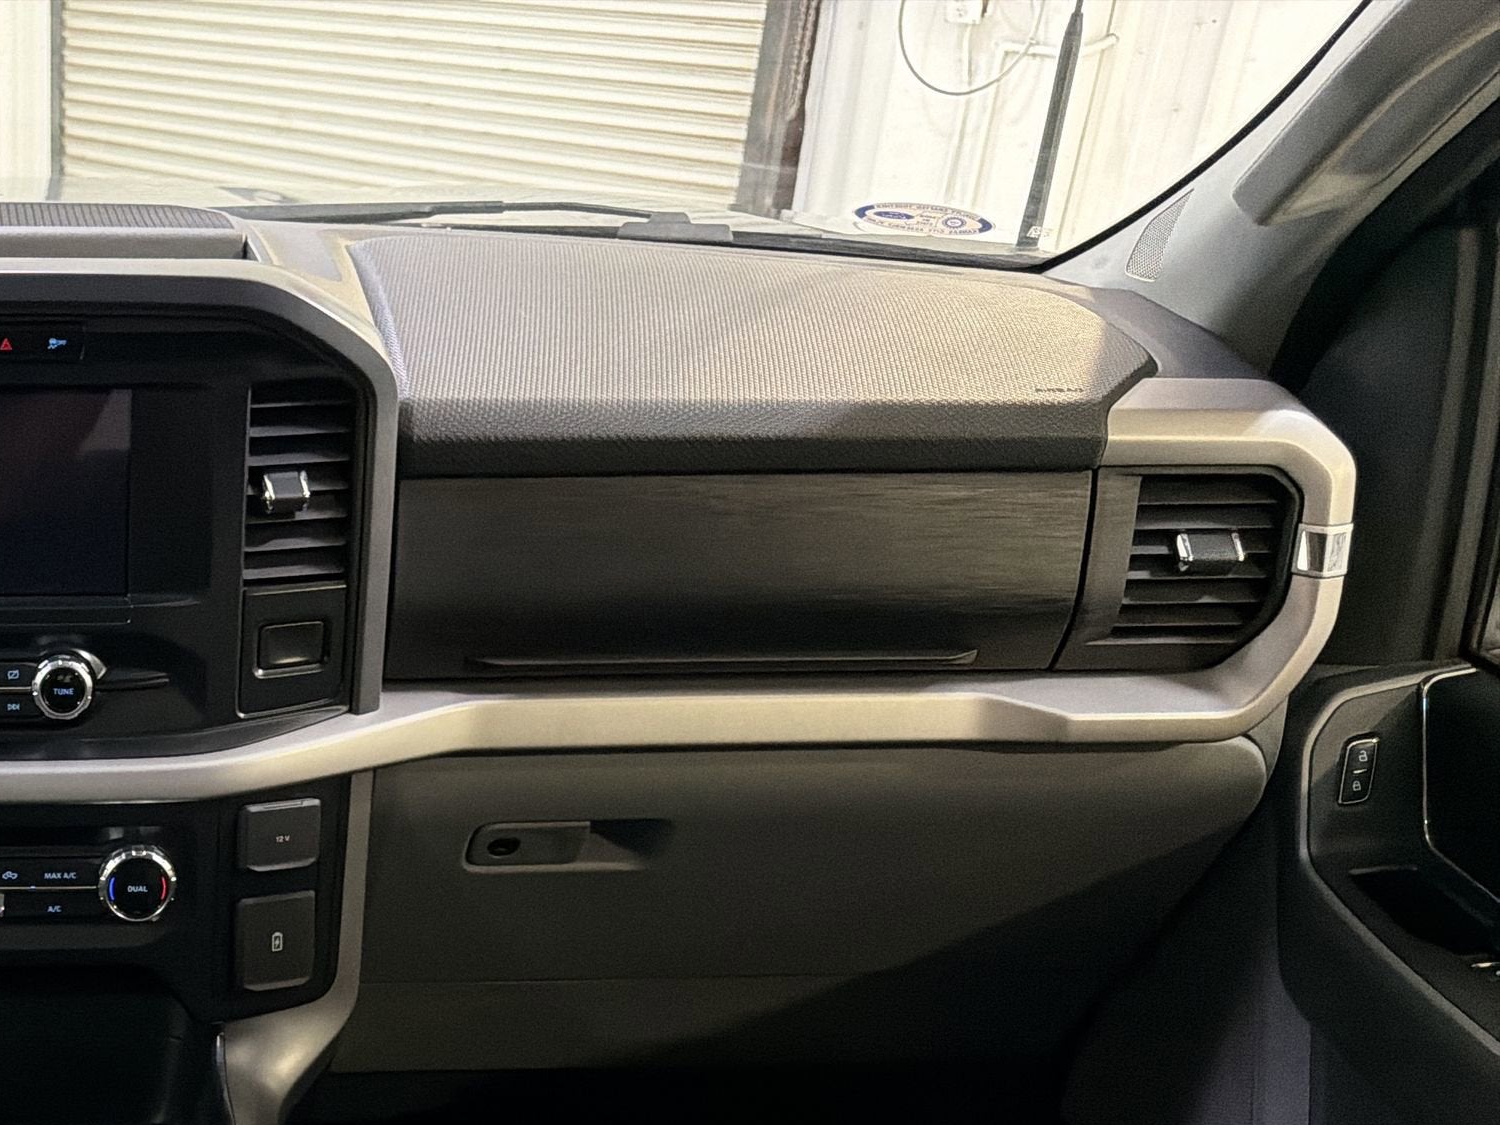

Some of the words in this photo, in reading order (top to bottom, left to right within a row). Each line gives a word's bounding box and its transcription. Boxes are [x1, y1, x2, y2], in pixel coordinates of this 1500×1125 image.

[52, 687, 75, 696] TUNE
[43, 871, 58, 880] MAX
[58, 871, 77, 880] A/C
[127, 885, 149, 893] DUAL
[47, 905, 62, 913] A/C
